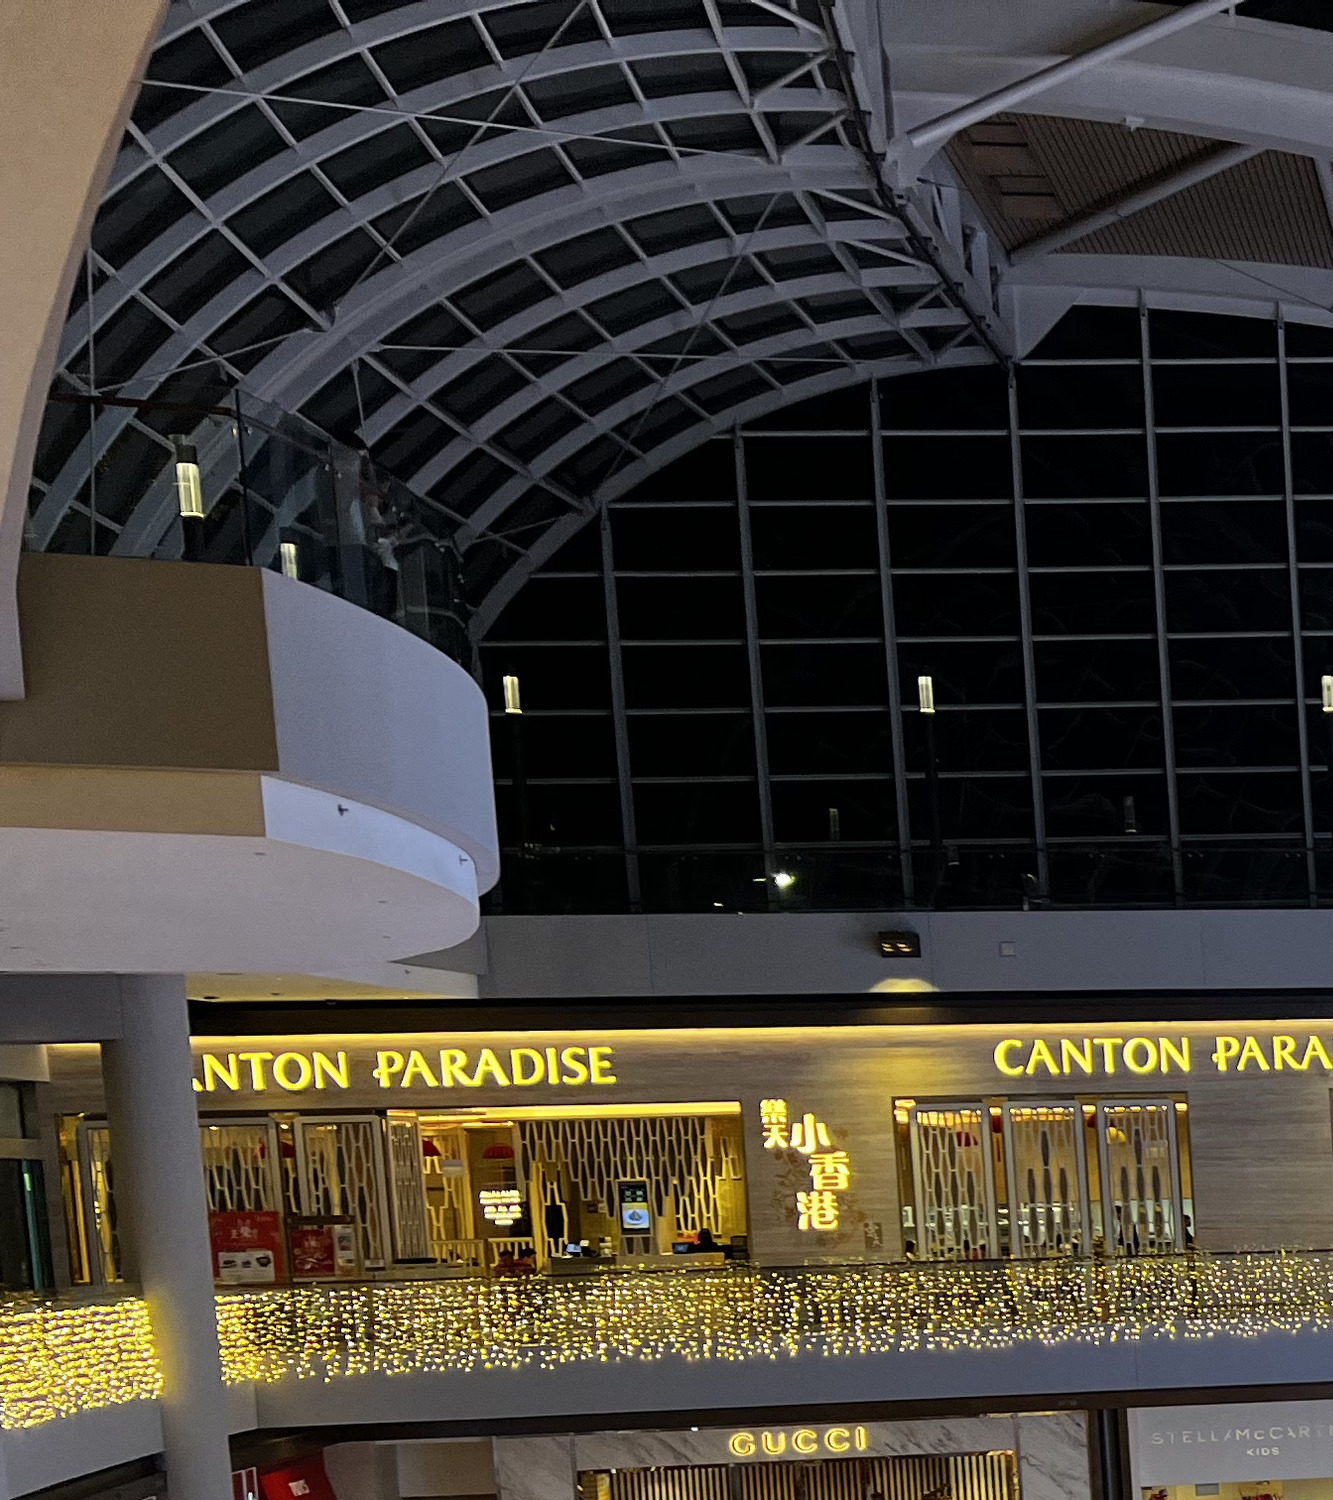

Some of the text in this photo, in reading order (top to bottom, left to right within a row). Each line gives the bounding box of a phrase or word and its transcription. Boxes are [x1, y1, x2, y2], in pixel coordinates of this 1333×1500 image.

[192, 1046, 617, 1091] NTON PARADISE
[993, 1037, 1190, 1076] CANTON
[790, 1113, 851, 1231] 小香港
[729, 1426, 867, 1457] GUCCI
[1246, 1446, 1280, 1457] KIDS
